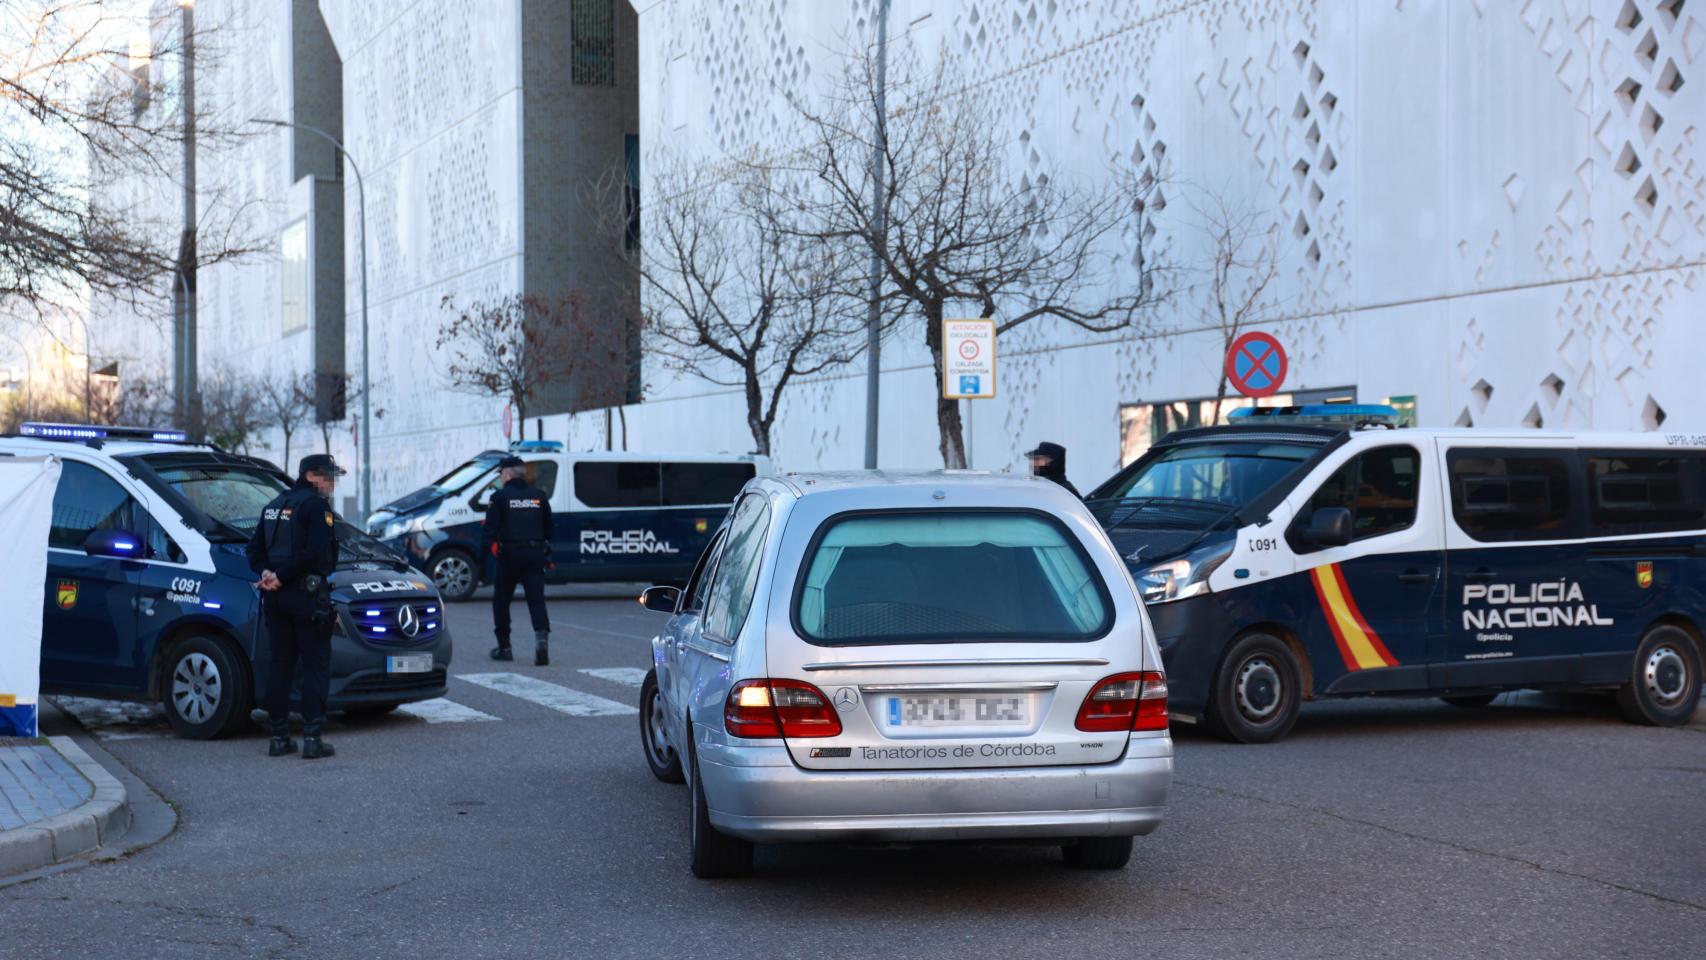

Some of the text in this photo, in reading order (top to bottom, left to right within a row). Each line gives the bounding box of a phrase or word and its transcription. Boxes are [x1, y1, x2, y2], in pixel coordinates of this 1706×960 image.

[580, 529, 656, 542] POLICÍA
[580, 541, 679, 554] NACIONAL
[1255, 538, 1277, 551] 091
[178, 577, 202, 594] 091
[1462, 577, 1584, 605] POLICÍA
[1462, 604, 1614, 630] NACIONAL
[858, 745, 947, 760] Tanatorios
[952, 744, 975, 758] de
[980, 742, 1056, 757] Córdoba
